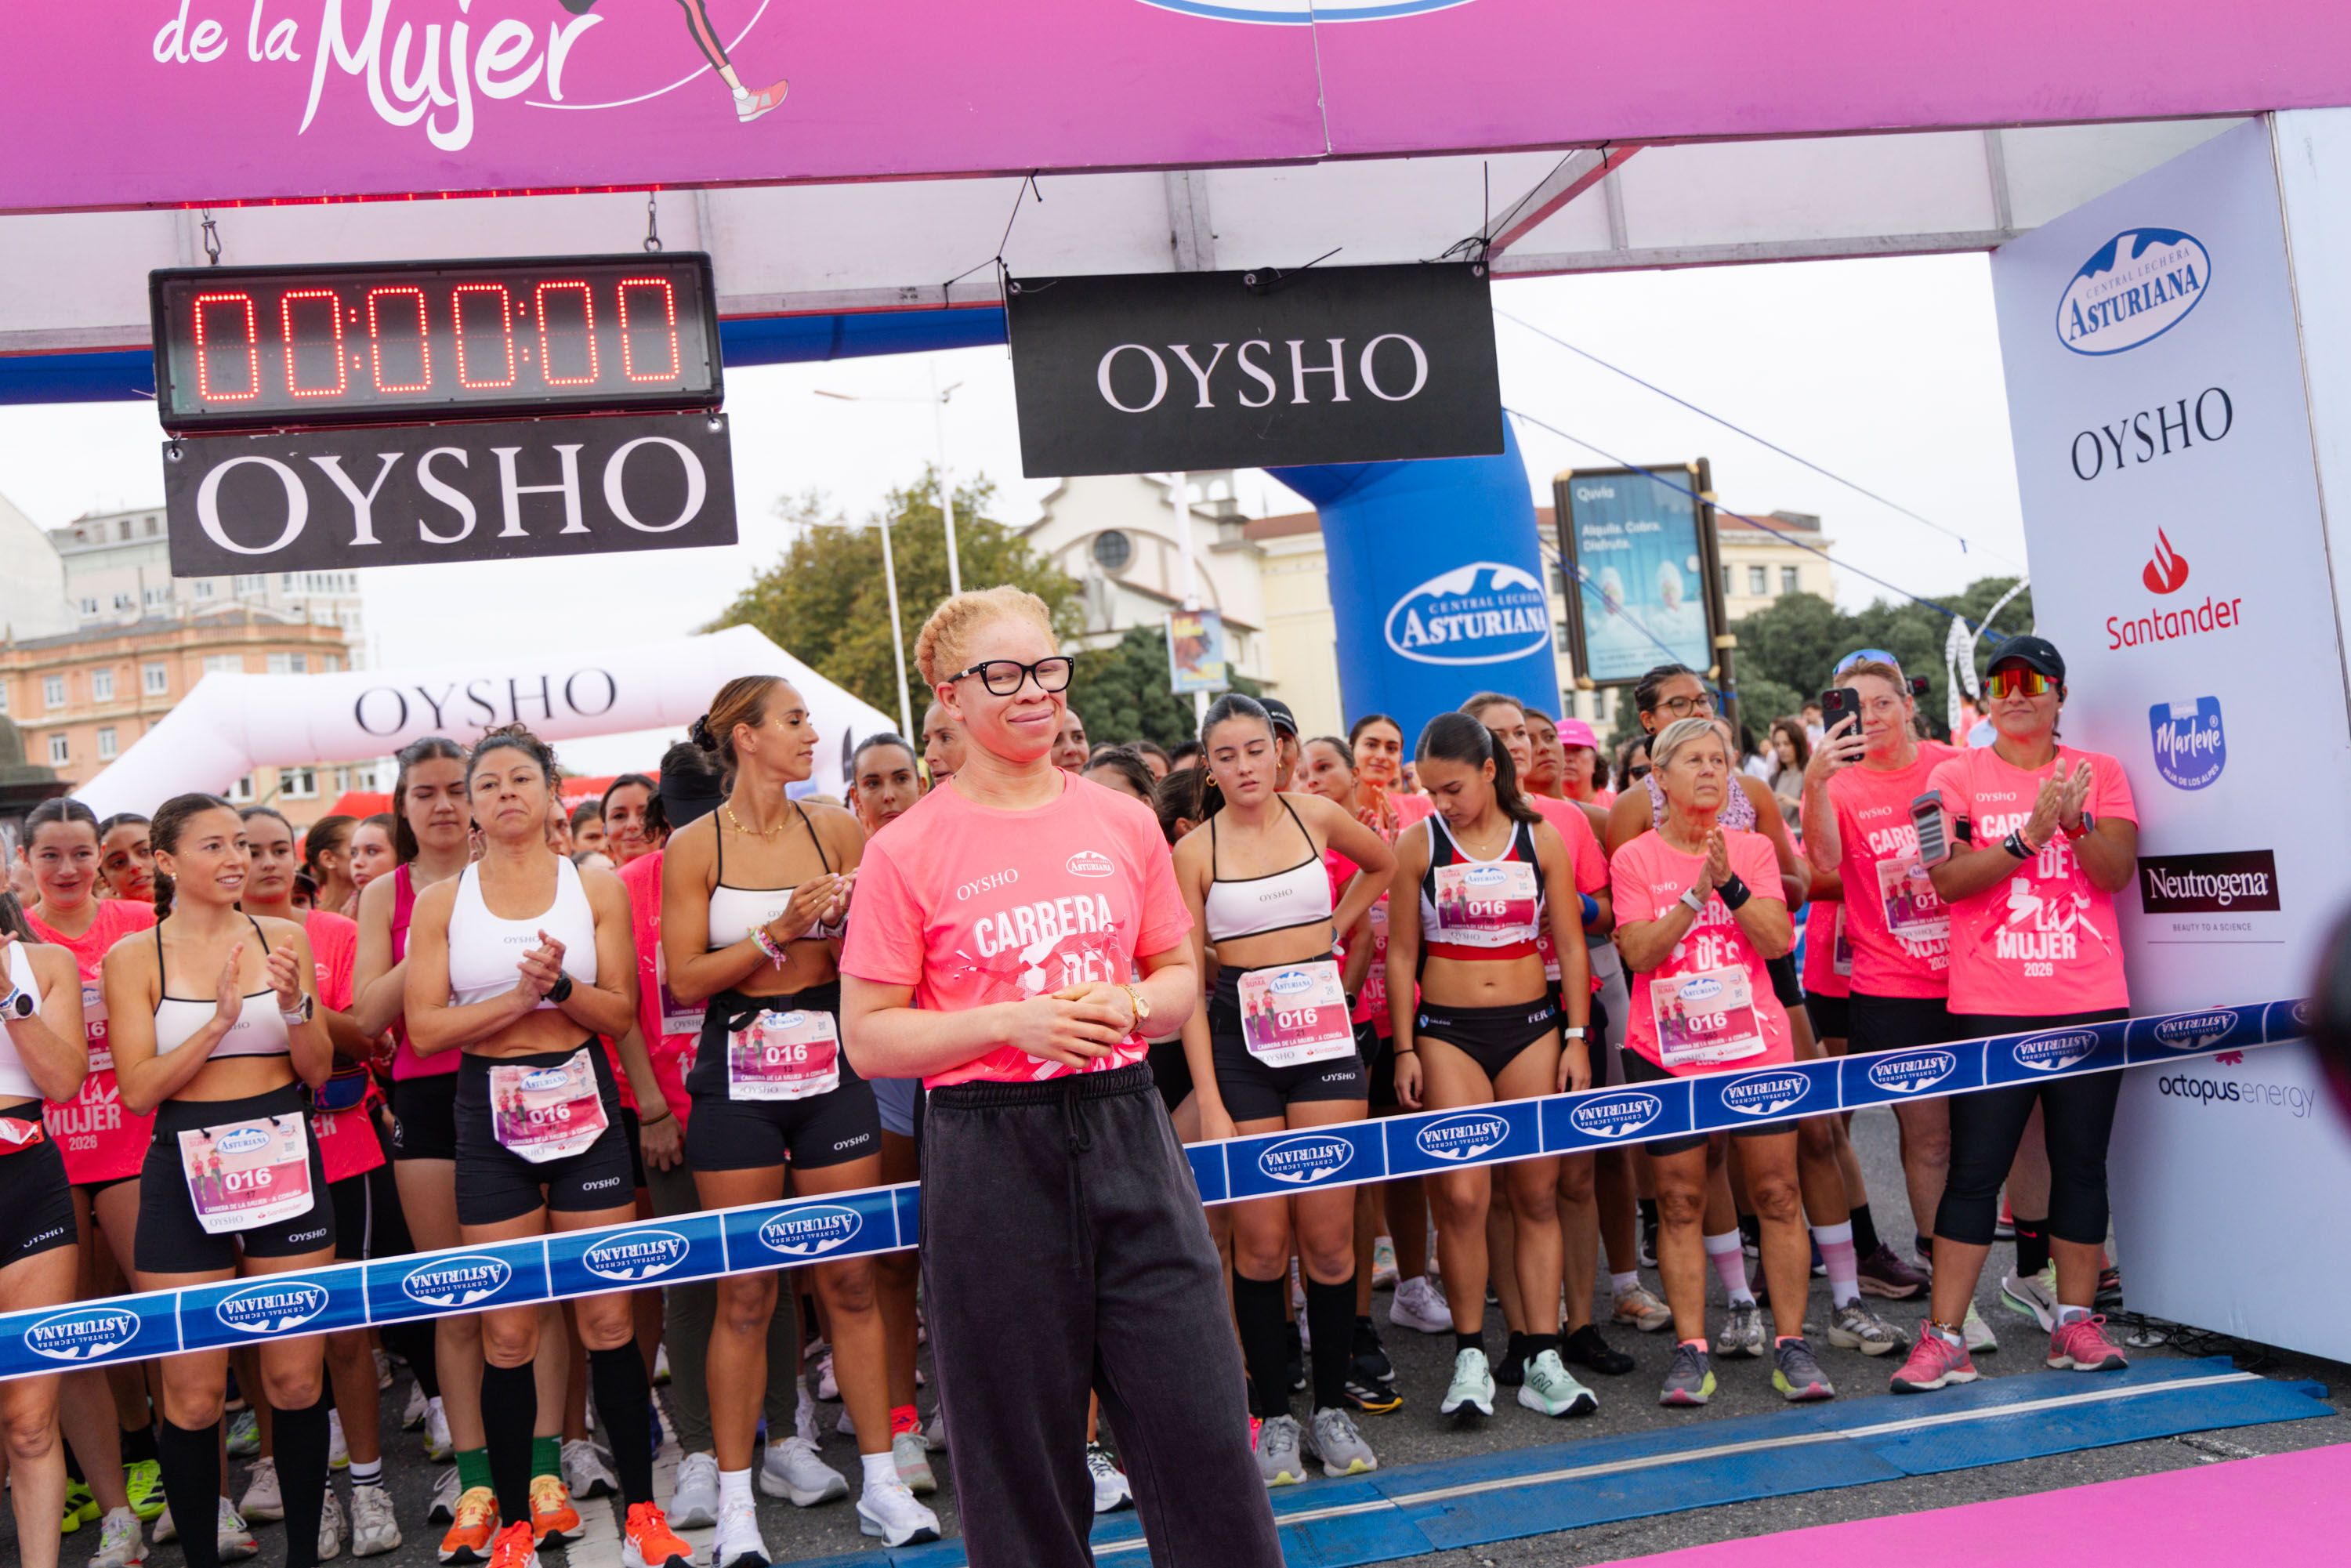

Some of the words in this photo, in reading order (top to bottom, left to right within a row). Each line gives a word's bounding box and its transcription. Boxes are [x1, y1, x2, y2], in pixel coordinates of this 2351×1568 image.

[153, 0, 228, 63] de
[248, 0, 301, 62] la
[298, 0, 604, 151] Mujer
[2086, 270, 2133, 299] CENTRAL
[2138, 247, 2190, 277] LECHERA
[2069, 263, 2201, 341] ASTURIANA
[194, 279, 680, 401] 00:00:00
[1097, 333, 1429, 413] OYSHO
[2071, 387, 2233, 480] OYSHO
[195, 436, 708, 556] OYSHO
[1428, 596, 1494, 615] CENTRAL
[2106, 596, 2241, 650] Santander
[354, 667, 617, 737] OYSHO
[1976, 791, 2016, 802] OYSHO
[1868, 824, 1917, 855] CARR
[1071, 861, 1111, 872] ASTURIANA
[2038, 846, 2069, 878] DE
[957, 868, 1018, 900] OYSHO
[2146, 867, 2269, 906] Neutrogena
[1259, 889, 1294, 903] OYSHO
[1469, 900, 1506, 916] 016
[973, 893, 1114, 958] CARRERA
[2173, 923, 2199, 932] BEAUTY
[1451, 932, 1480, 941] OYSHO
[1997, 932, 2076, 959] MUJER
[2024, 962, 2053, 976] 2026
[1273, 981, 1310, 991] ASTURIANA
[1278, 1009, 1318, 1028] 016
[1688, 1012, 1727, 1032] 016
[2162, 1013, 2233, 1033] ASTURIANA
[2020, 1034, 2092, 1056] ASTURIANA
[2052, 1048, 2079, 1058] CENTRAL
[766, 1045, 808, 1063] 016
[2022, 1052, 2051, 1061] LECHERA
[1876, 1056, 1950, 1076] ASTURIANA
[1878, 1074, 1907, 1082] LECHERA
[1909, 1070, 1936, 1079] CENTRAL
[1728, 1077, 1803, 1099] ASTURIANA
[1731, 1095, 1760, 1105] LECHERA
[1762, 1092, 1791, 1101] CENTRAL
[529, 1103, 571, 1124] 016
[1578, 1099, 1654, 1121] ASTURIANA
[1581, 1117, 1610, 1127] LECHERA
[1613, 1114, 1642, 1123] CENTRAL
[1423, 1121, 1502, 1143] ASTURIANA
[69, 1135, 97, 1151] 2026
[222, 1137, 266, 1150] ASTURIANA
[834, 1133, 870, 1151] OYSHO
[1426, 1140, 1458, 1150] LECHERA
[1458, 1136, 1490, 1146] CENTRAL
[1266, 1143, 1346, 1164] ASTURIANA
[1270, 1162, 1301, 1172] LECHERA
[1302, 1158, 1333, 1168] CENTRAL
[225, 1168, 273, 1190] 016
[582, 1176, 620, 1191] OYSHO
[209, 1215, 244, 1227] OYSHO
[766, 1213, 854, 1237] ASTURIANA
[288, 1227, 327, 1243] OYSHO
[771, 1233, 805, 1244] LECHERA
[807, 1229, 840, 1240] CENTRAL
[591, 1238, 682, 1262] ASTURIANA
[596, 1258, 630, 1269] LECHERA
[632, 1255, 667, 1266] CENTRAL
[410, 1264, 502, 1287] ASTURIANA
[415, 1285, 451, 1295] LECHERA
[452, 1280, 488, 1291] CENTRAL
[224, 1289, 319, 1315] ASTURIANA
[229, 1310, 265, 1322] LECHERA
[267, 1306, 304, 1318] CENTRAL
[34, 1316, 132, 1342] ASTURIANA
[38, 1337, 76, 1349] LECHERA
[78, 1333, 116, 1344] CENTRAL
